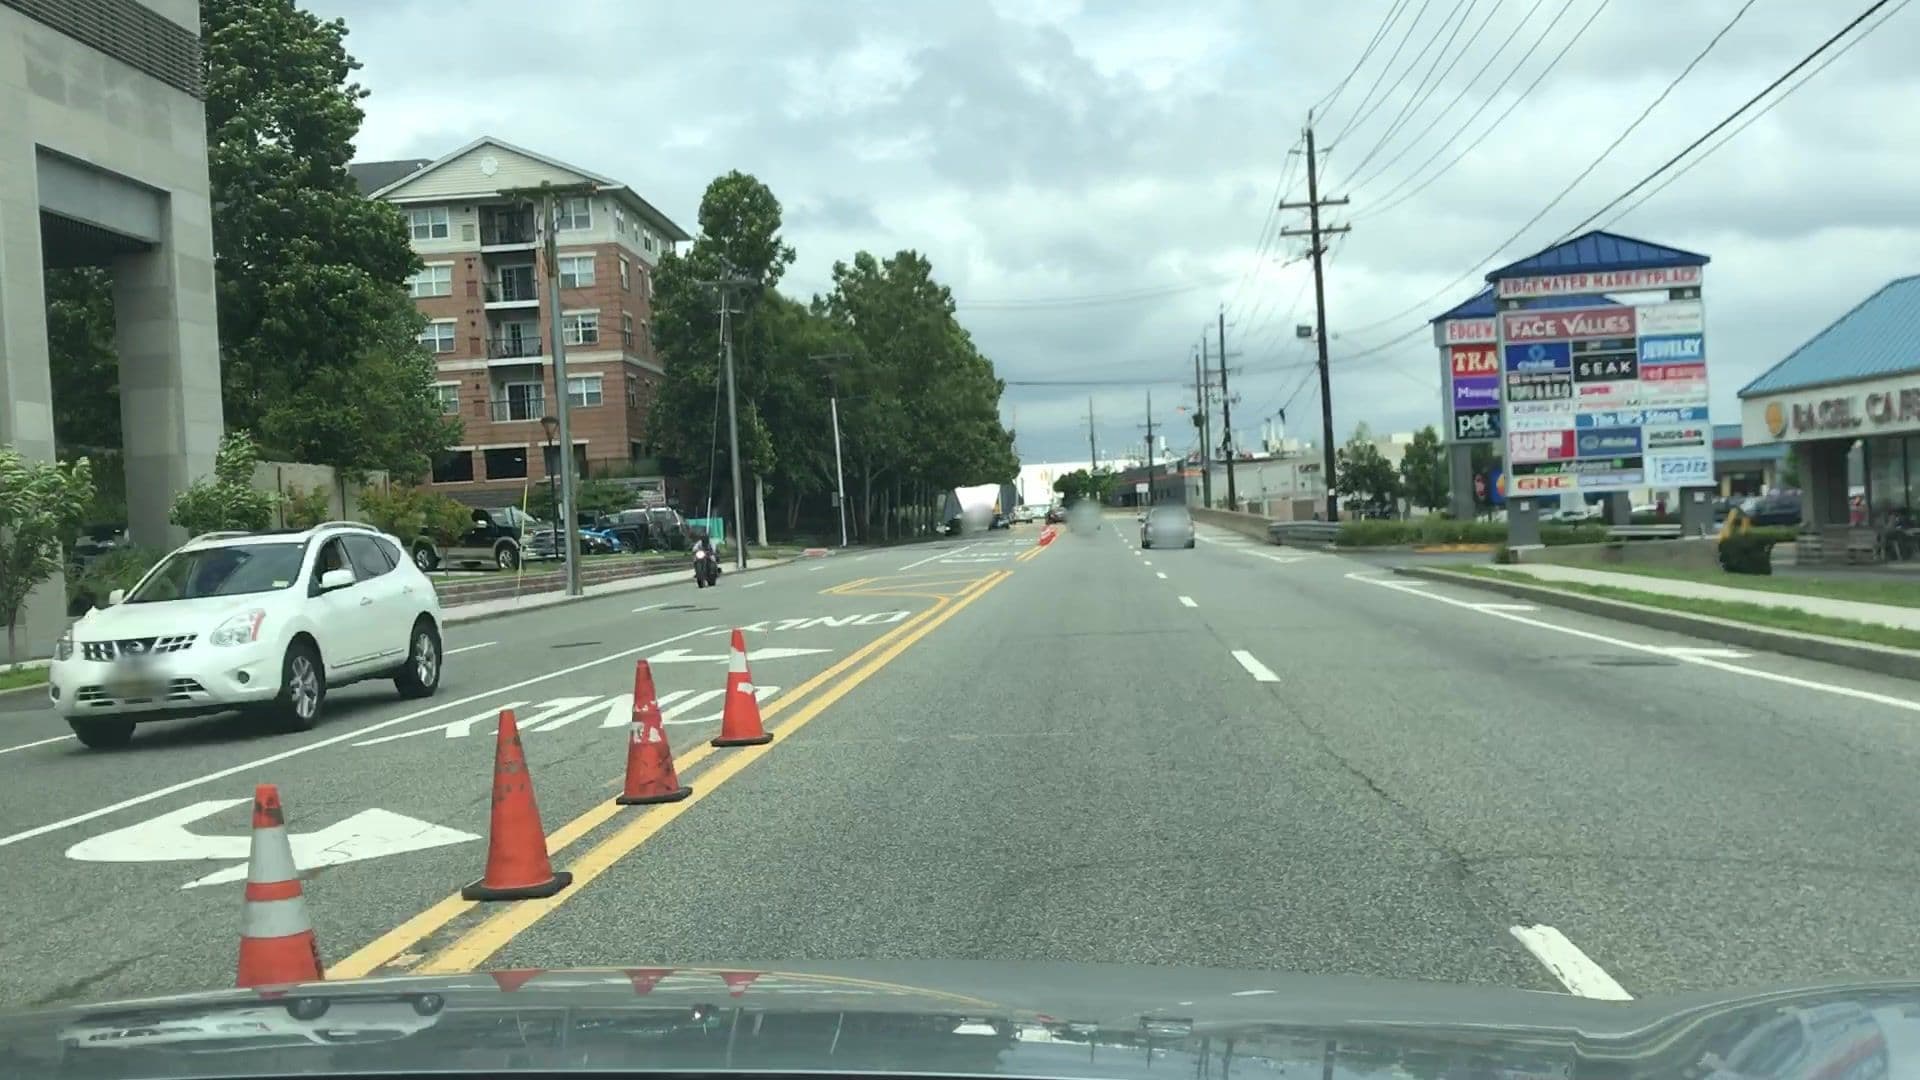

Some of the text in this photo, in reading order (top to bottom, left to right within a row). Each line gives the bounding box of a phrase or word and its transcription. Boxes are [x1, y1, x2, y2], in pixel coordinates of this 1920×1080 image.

[1510, 320, 1557, 338] FACE
[1561, 313, 1630, 336] VALUES
[1517, 476, 1569, 490] GNC
